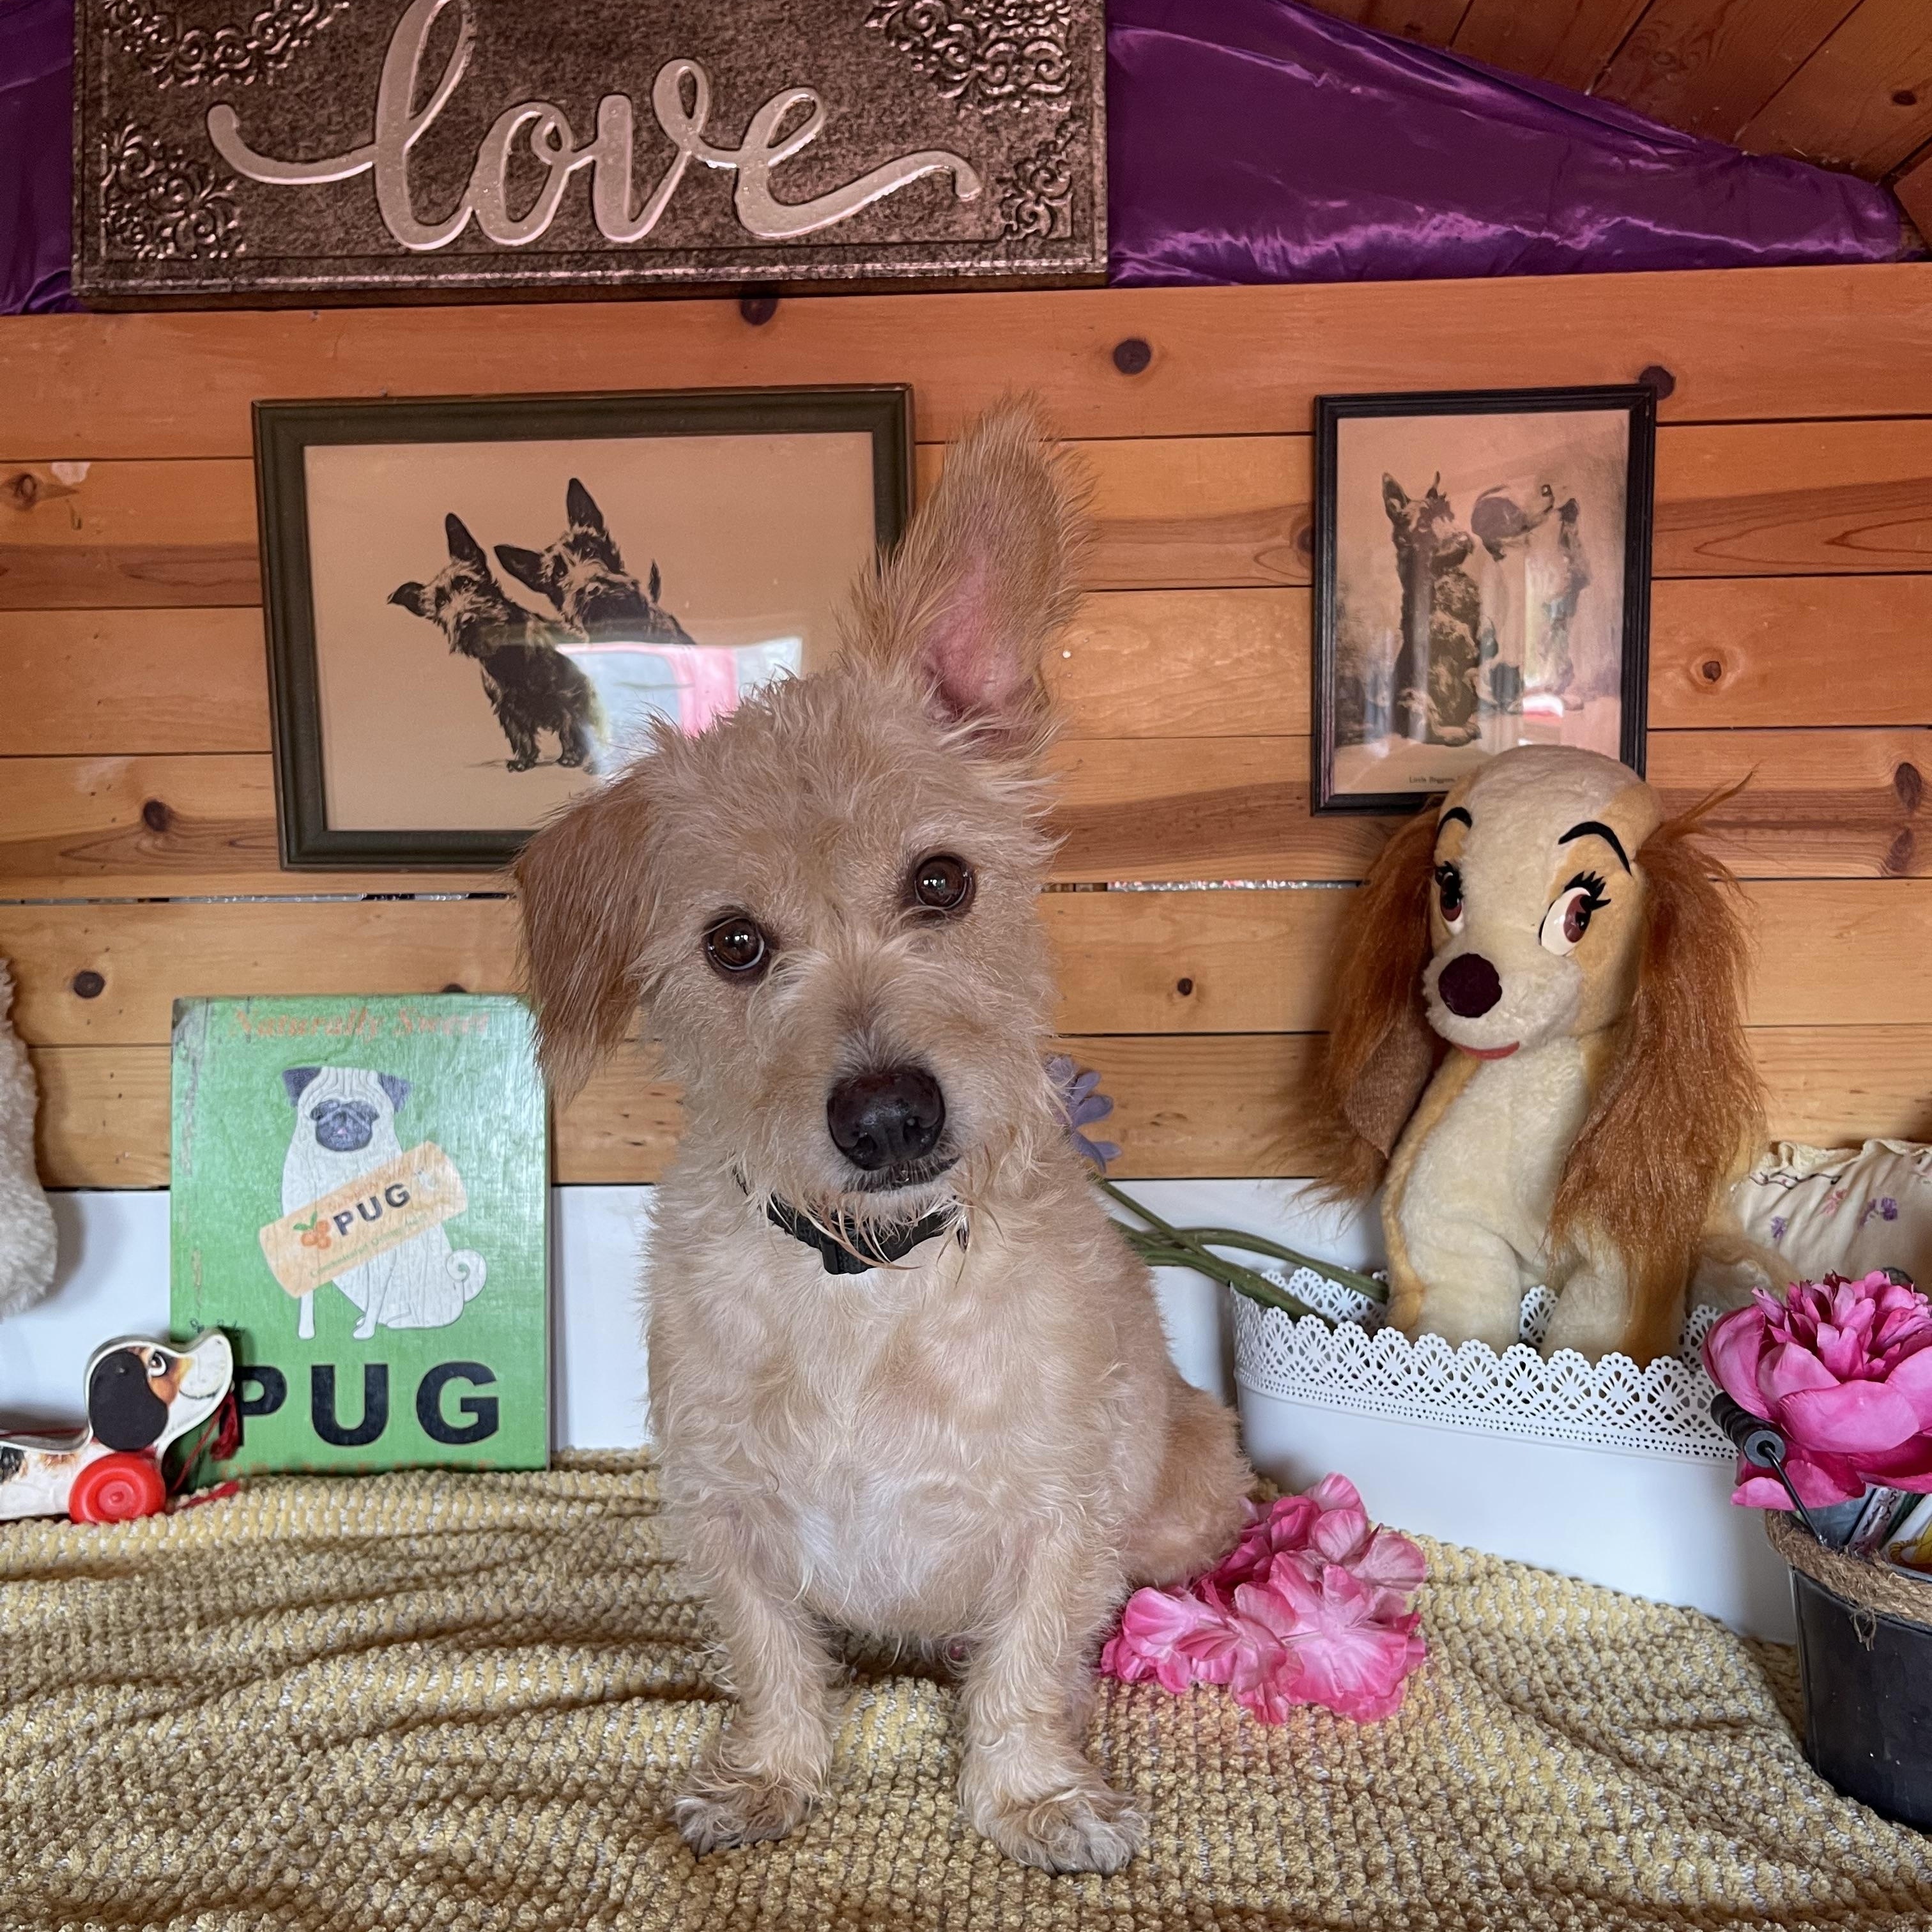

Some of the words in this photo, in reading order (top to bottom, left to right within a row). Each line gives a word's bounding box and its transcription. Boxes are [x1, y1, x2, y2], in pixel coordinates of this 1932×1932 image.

[207, 0, 982, 250] love
[228, 1004, 385, 1045] Naturally
[333, 1182, 411, 1236] PUG
[219, 1361, 500, 1447] PUG
